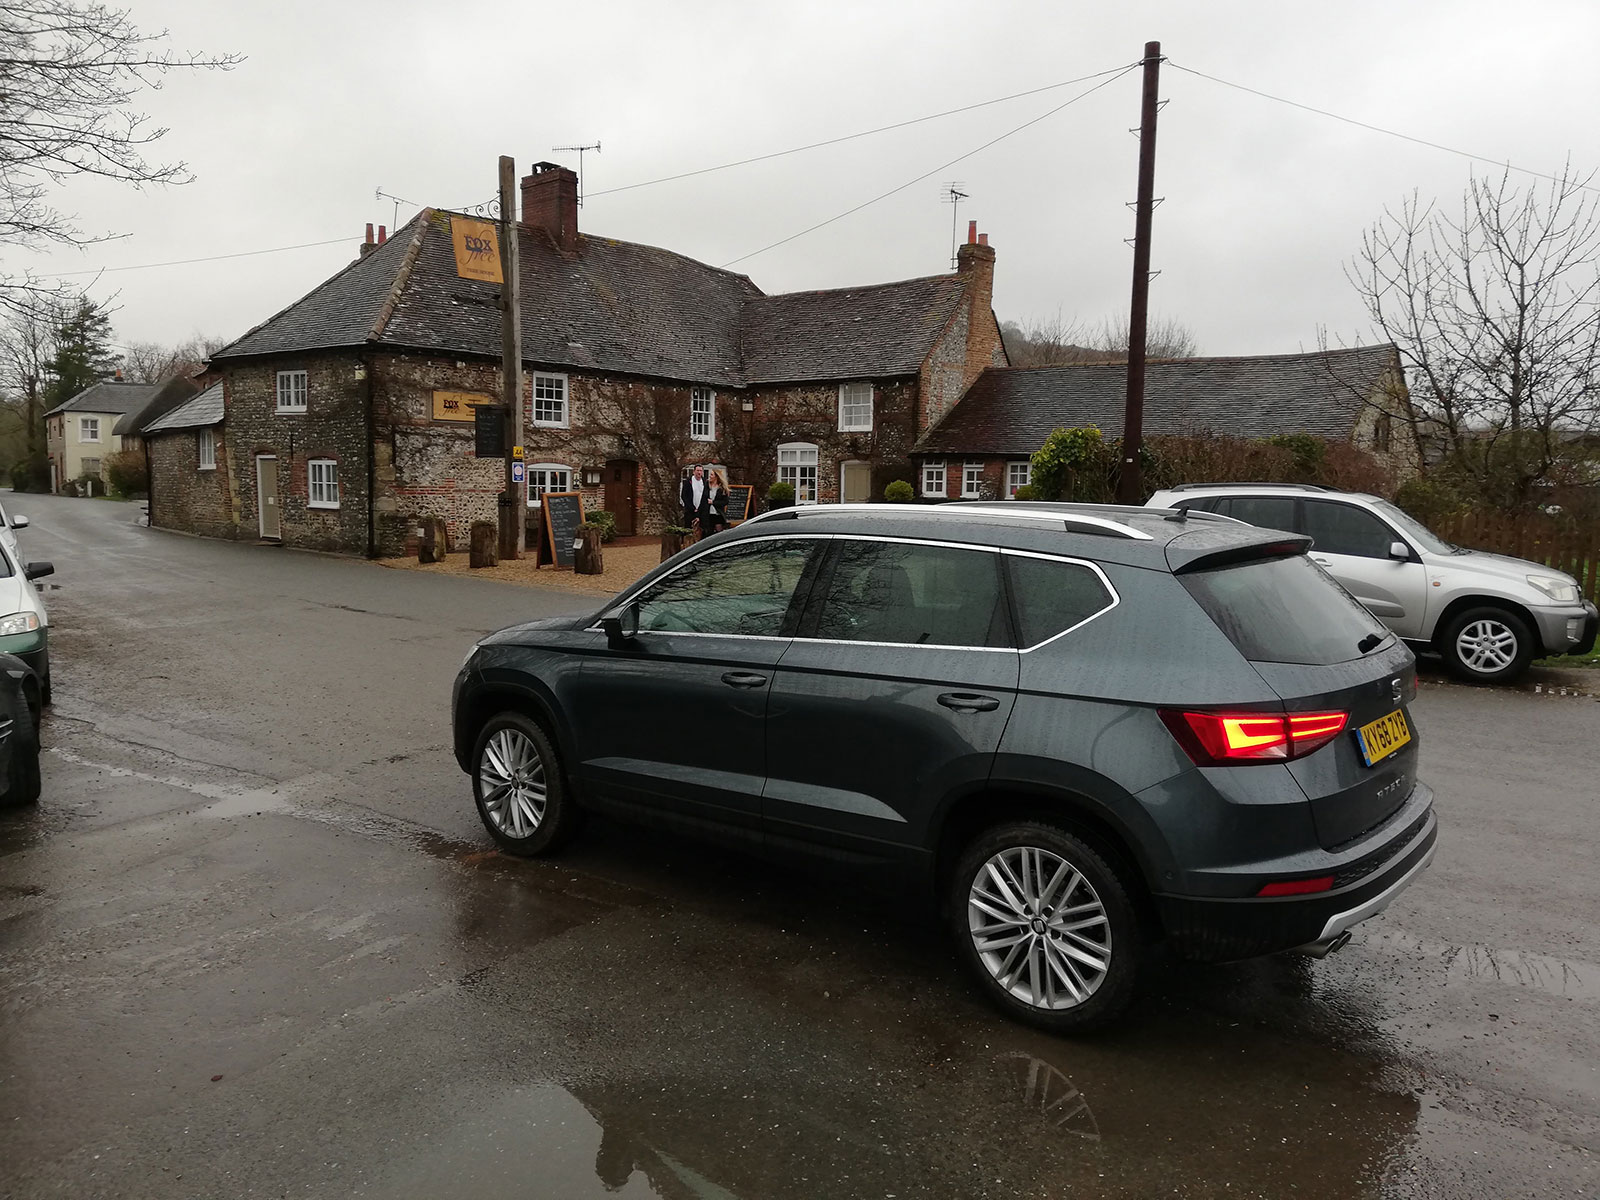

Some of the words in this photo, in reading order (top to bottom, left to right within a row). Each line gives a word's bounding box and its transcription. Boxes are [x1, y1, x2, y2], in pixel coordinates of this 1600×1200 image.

[464, 234, 493, 252] FOX
[443, 399, 459, 409] FOX
[1363, 720, 1392, 756] KY68
[1387, 711, 1407, 742] ZYB
